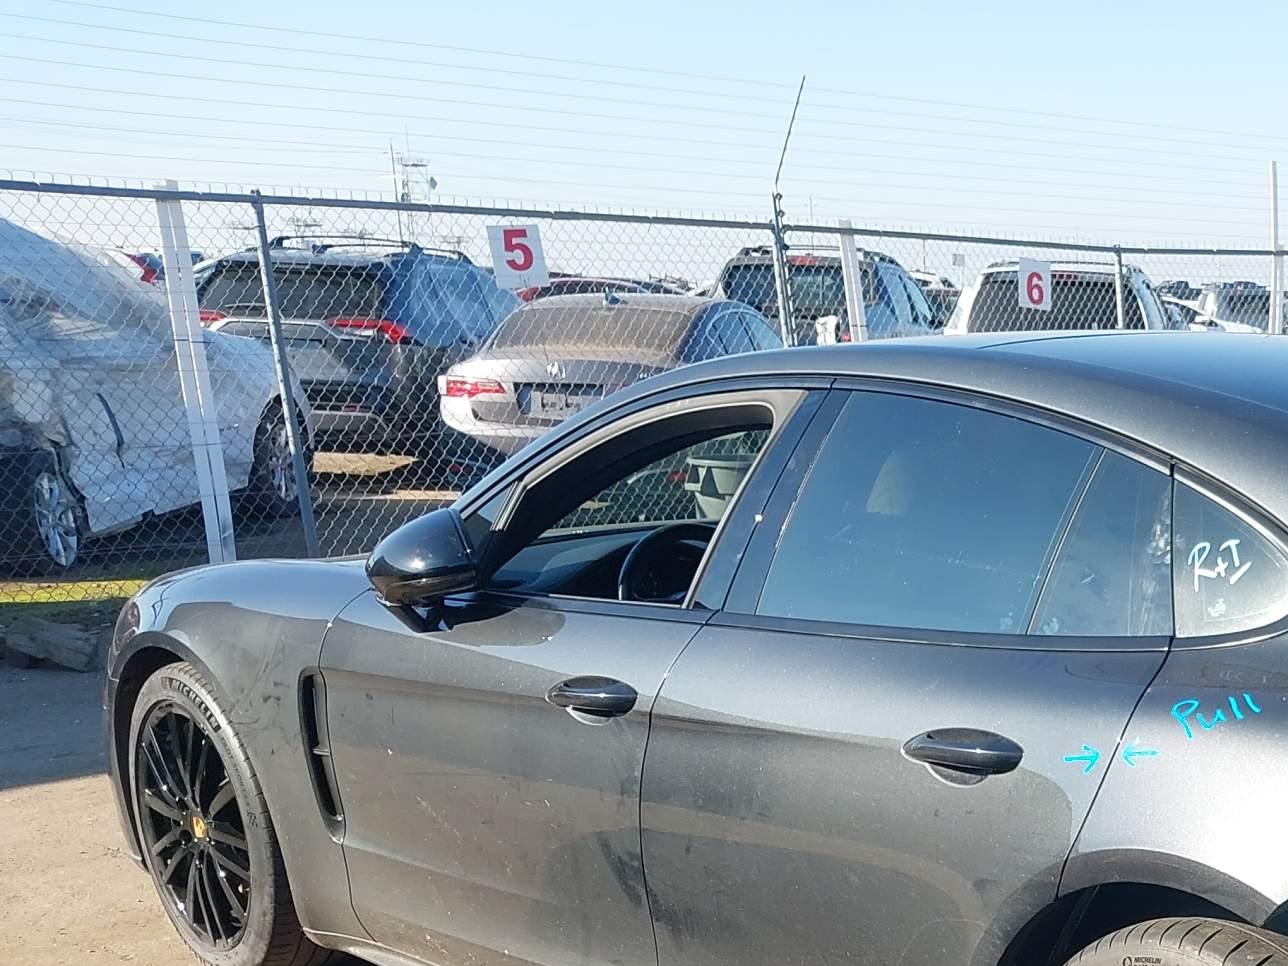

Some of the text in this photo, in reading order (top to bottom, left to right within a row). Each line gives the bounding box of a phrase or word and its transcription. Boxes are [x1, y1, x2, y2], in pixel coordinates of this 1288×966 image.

[503, 229, 534, 271] 5
[1026, 271, 1044, 306] 6
[170, 679, 220, 730] MICHELIN
[1171, 692, 1262, 739] Pull
[1133, 956, 1162, 964] MICHELIN
